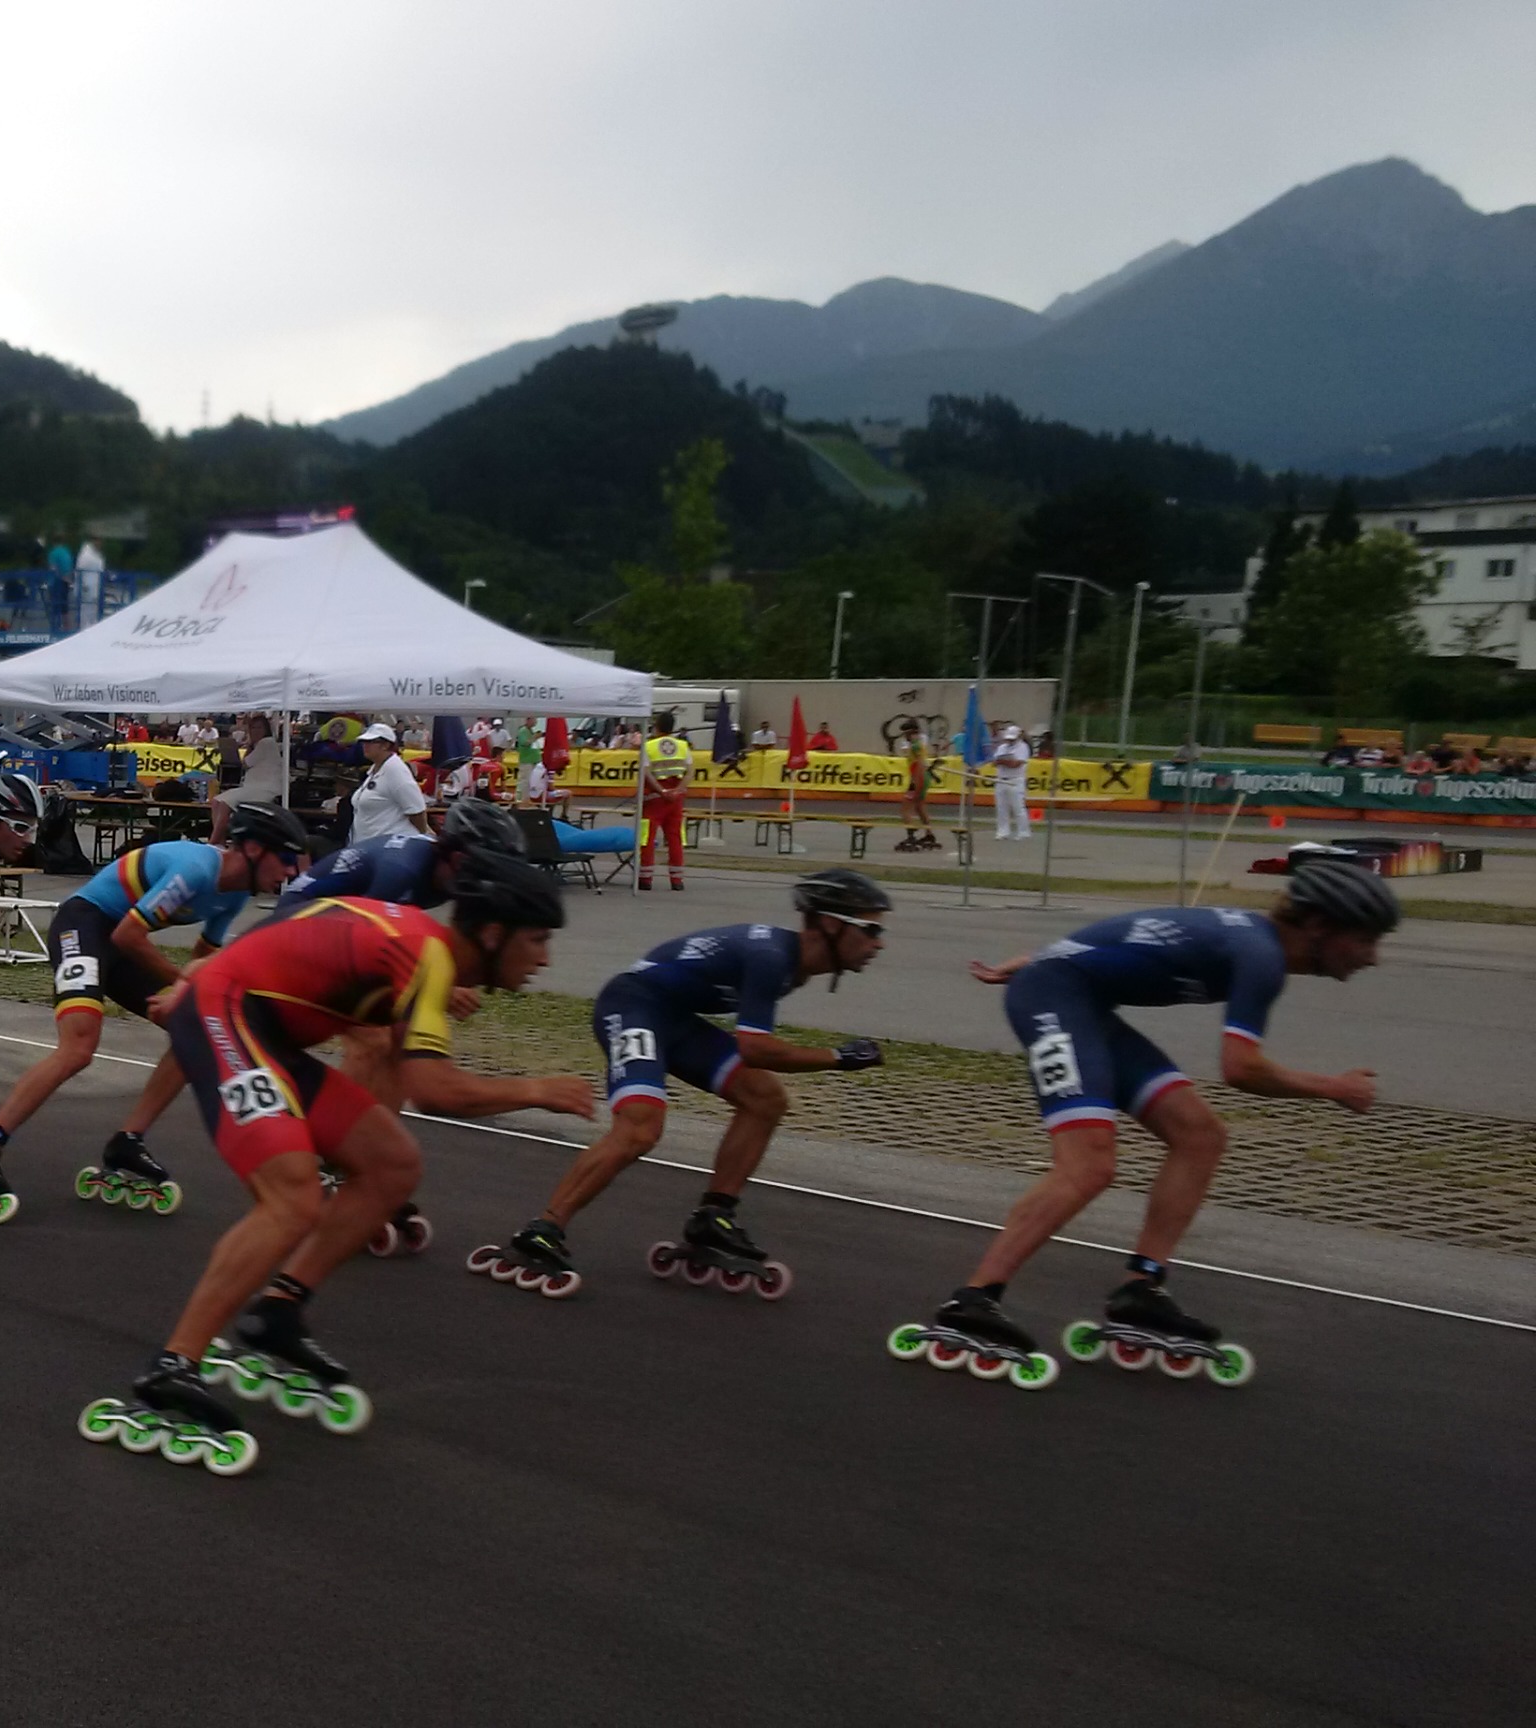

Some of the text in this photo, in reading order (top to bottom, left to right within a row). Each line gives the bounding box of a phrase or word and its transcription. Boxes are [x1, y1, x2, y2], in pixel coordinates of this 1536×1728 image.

[131, 614, 227, 638] WÖRGL
[53, 684, 161, 704] Wir leben Visionen.
[390, 677, 564, 701] Wir leben Visionen.
[136, 750, 186, 773] eisen
[1433, 774, 1536, 802] Tageszeitun
[620, 1031, 646, 1059] 21
[228, 1074, 277, 1118] 28
